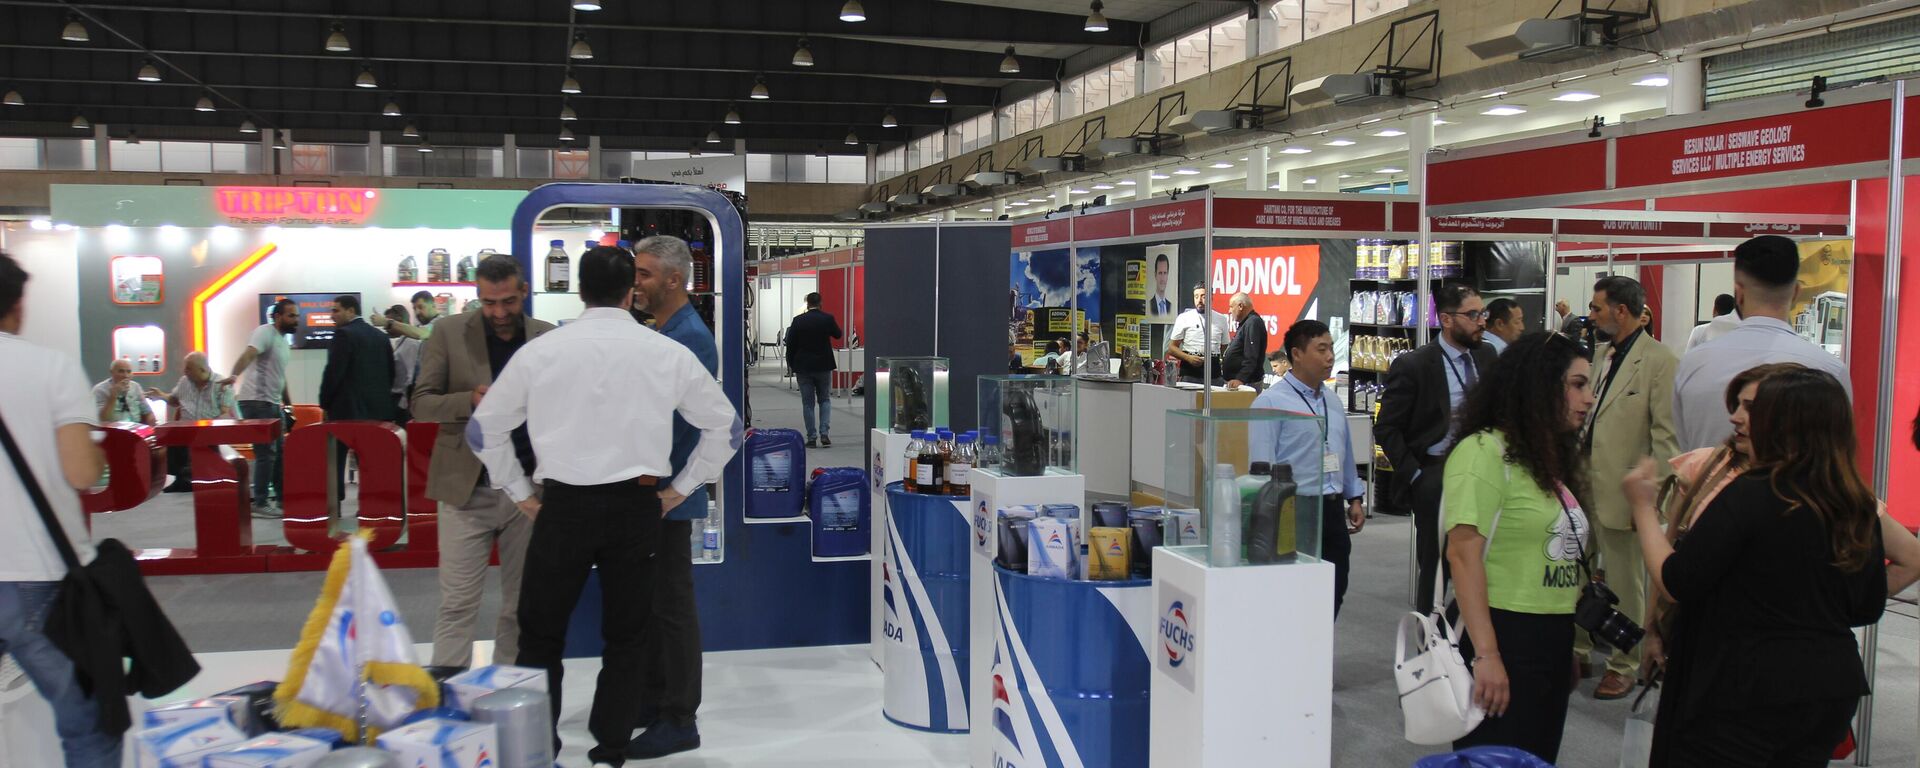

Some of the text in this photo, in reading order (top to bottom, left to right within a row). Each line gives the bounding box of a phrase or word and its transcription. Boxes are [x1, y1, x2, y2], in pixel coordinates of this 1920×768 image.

[1684, 137, 1704, 155] RESUN
[1704, 135, 1724, 152] SOLAR
[1728, 130, 1759, 149] SEISWAVE
[1760, 125, 1792, 146] GEOLOGY
[1672, 157, 1699, 175] SERVICES
[1700, 156, 1712, 172] LLC
[1715, 151, 1744, 170] MULTIPLE
[1746, 148, 1771, 167] ENERGY
[1772, 144, 1805, 164] SERVICES
[222, 190, 365, 213] TRIPTON
[1295, 205, 1303, 214] THE
[1329, 206, 1334, 215] OF
[230, 216, 249, 225] The
[1275, 215, 1287, 225] TRADE
[1287, 216, 1293, 225] OF
[1617, 221, 1663, 231] OPPORTUNITY
[1212, 256, 1302, 295] ADDNOL
[1159, 616, 1195, 653] FUCHS
